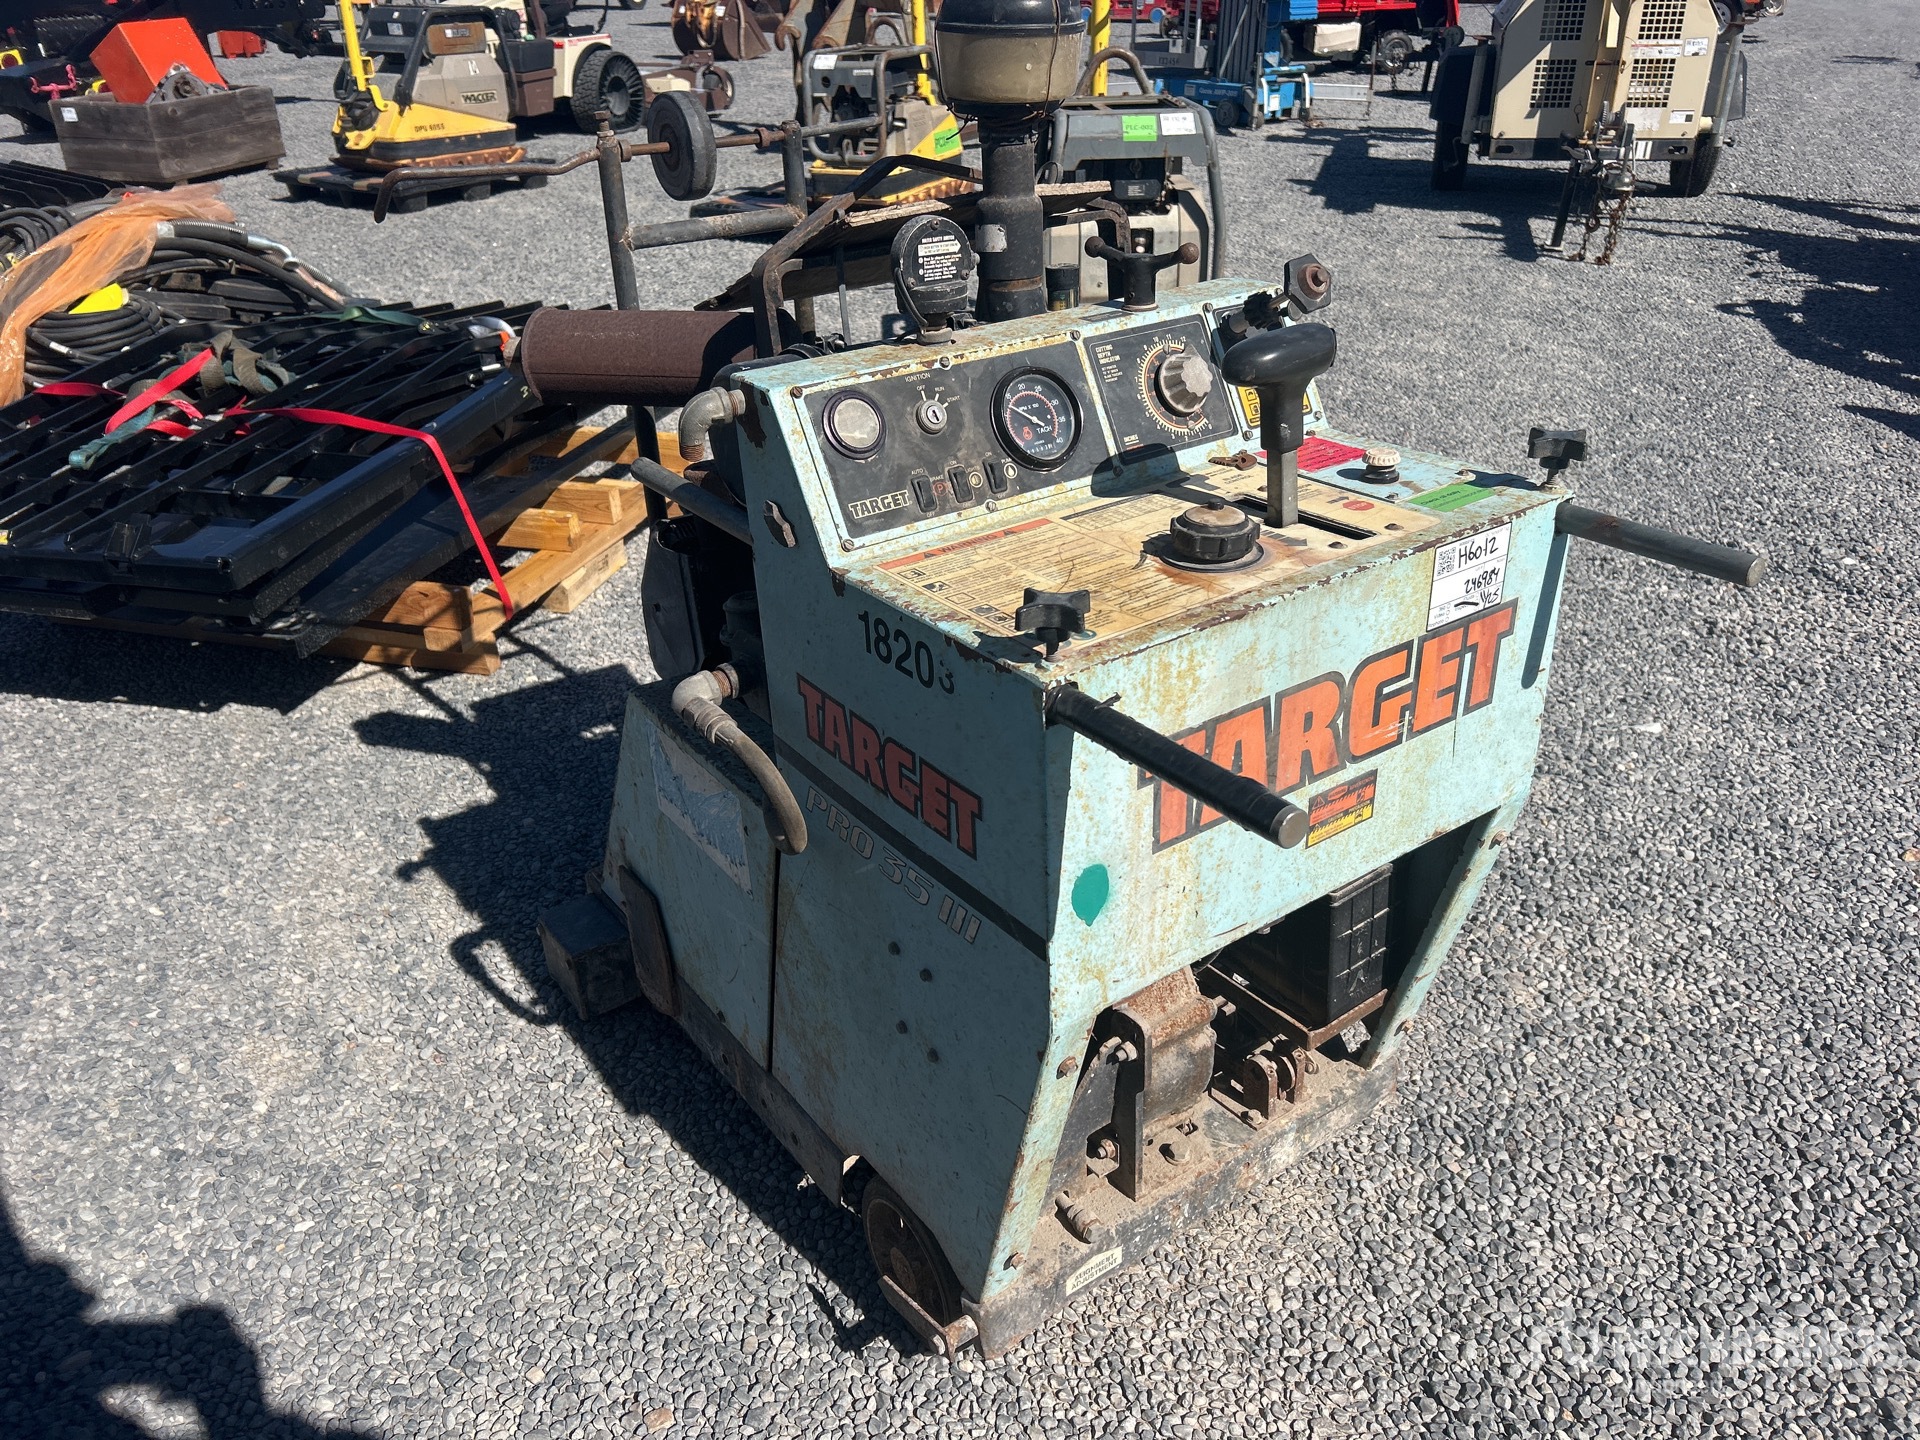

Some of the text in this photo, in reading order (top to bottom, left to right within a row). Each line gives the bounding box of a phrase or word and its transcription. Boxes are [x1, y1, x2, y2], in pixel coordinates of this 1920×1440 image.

[462, 92, 496, 103] WACKER
[1095, 344, 1113, 352] CUTTING
[1099, 355, 1121, 364] INDICATOR
[905, 372, 930, 382] IGNITION
[1036, 426, 1053, 434] TACH
[848, 490, 909, 519] TARGET
[938, 534, 997, 553] WARNING
[1137, 598, 1517, 854] TARGET
[796, 674, 983, 861] TARGET
[806, 786, 982, 944] PRO 35 III
[1072, 1258, 1117, 1290] ADJUSTMENT
[1075, 1253, 1114, 1282] ALIGNMENT
